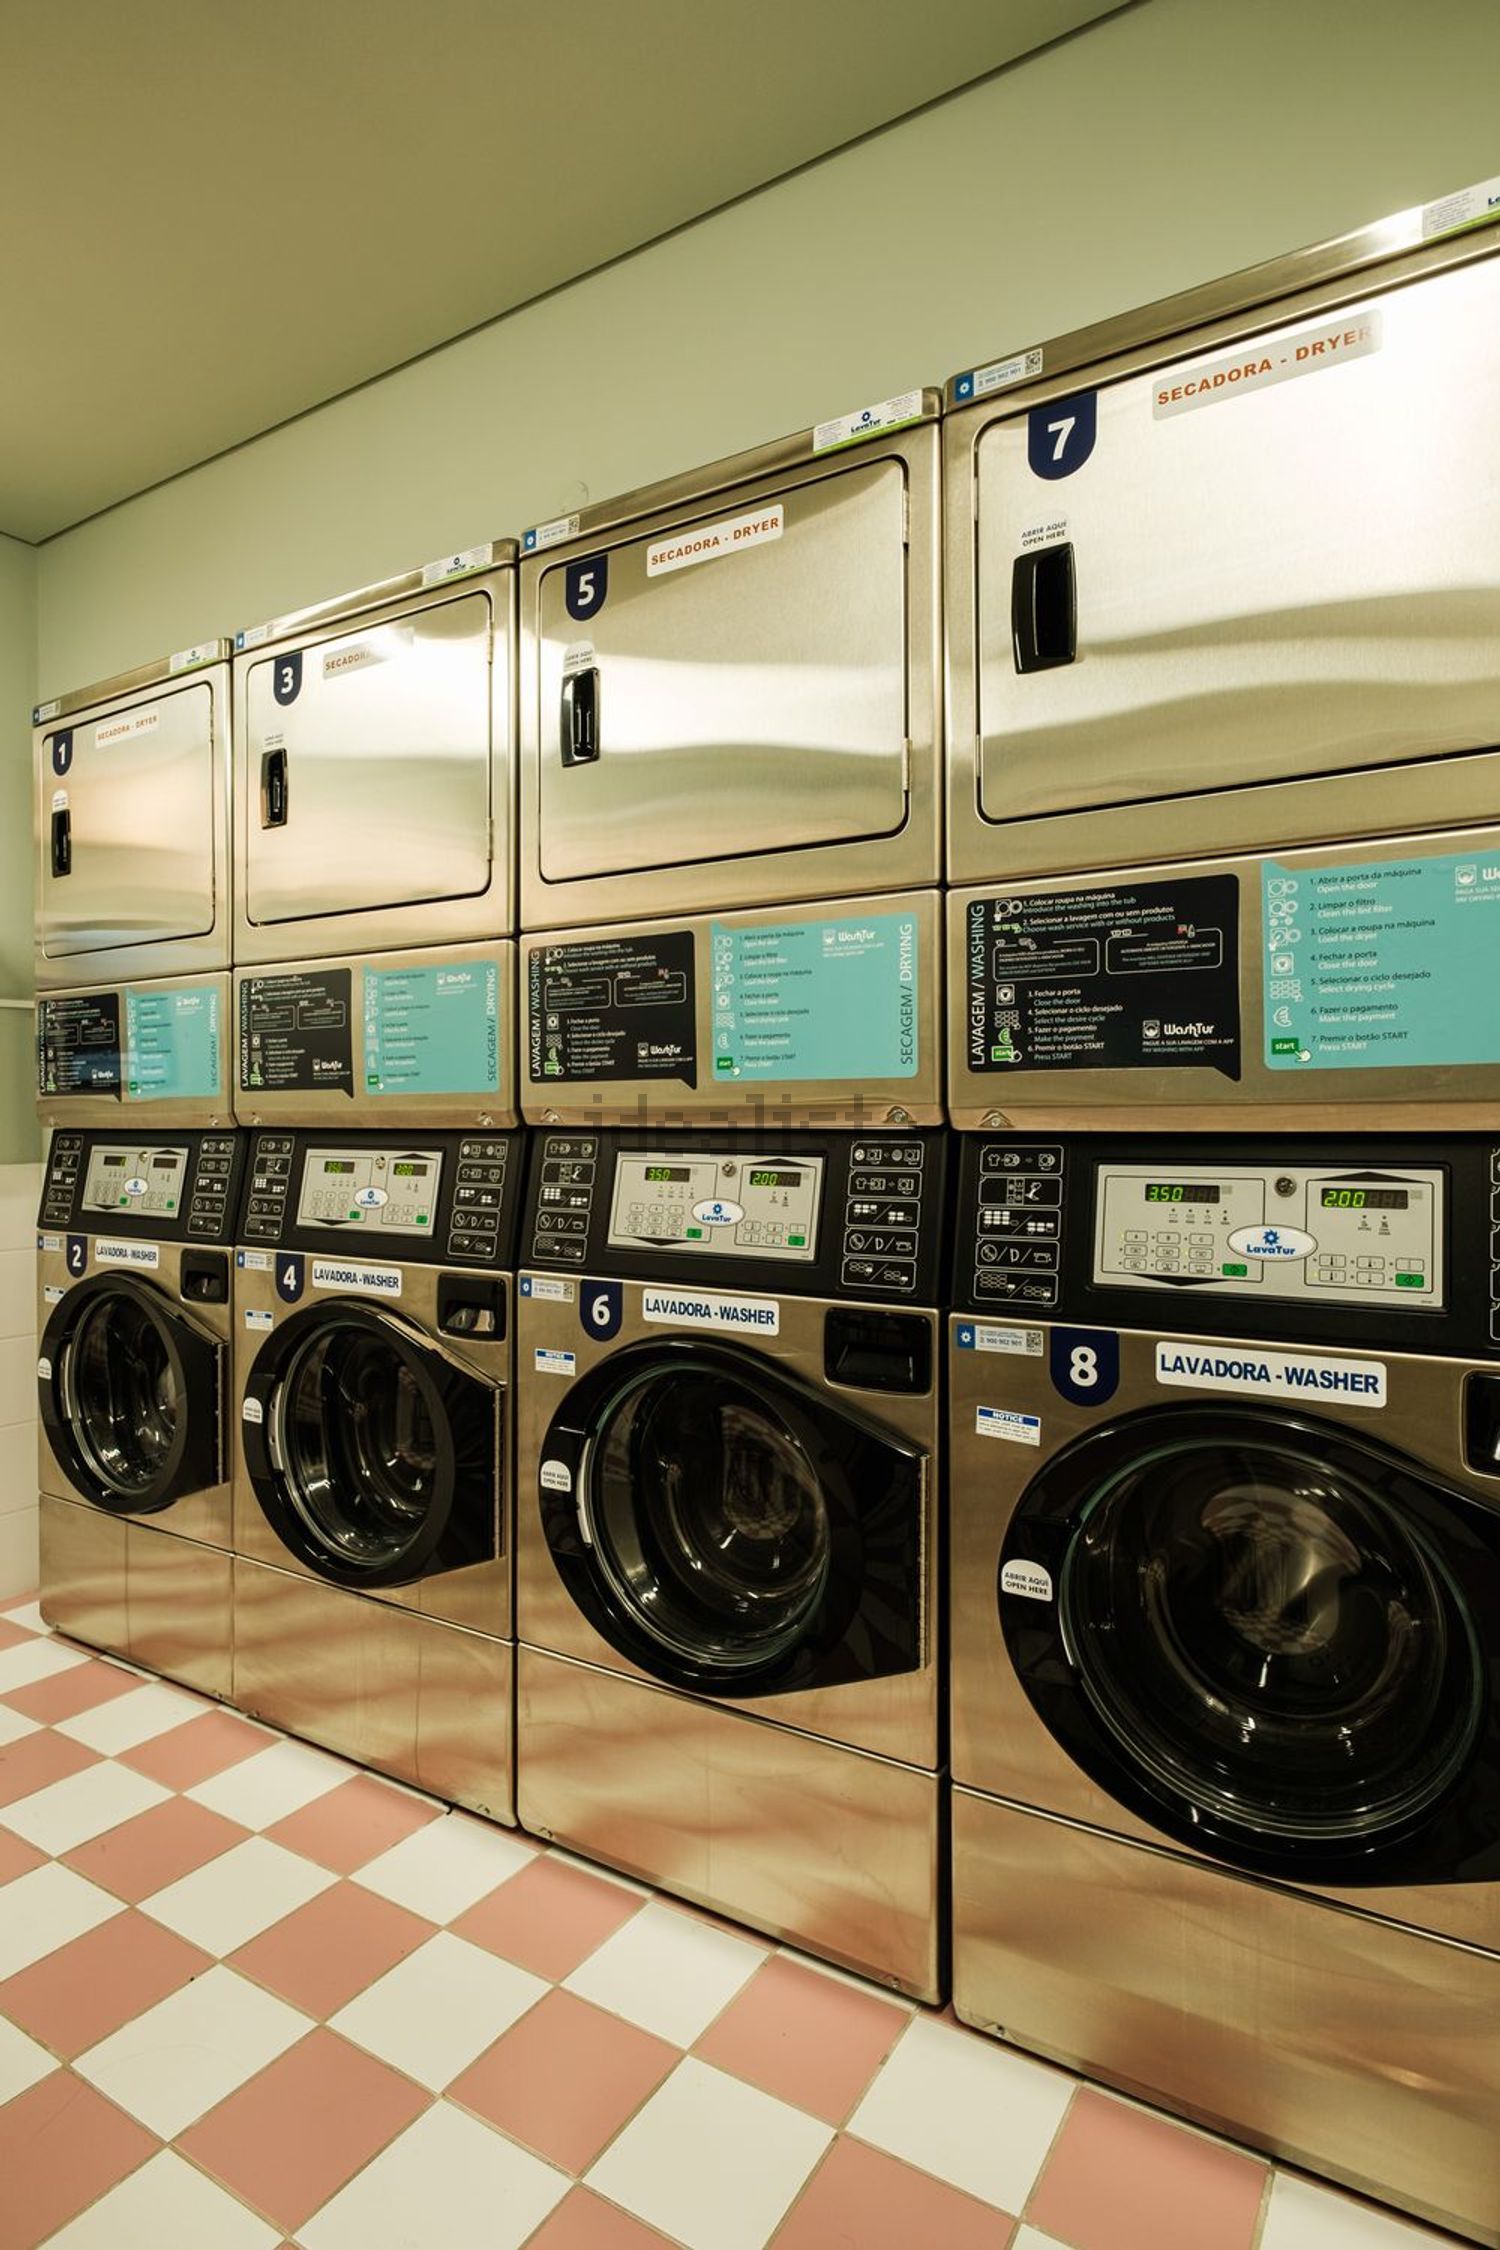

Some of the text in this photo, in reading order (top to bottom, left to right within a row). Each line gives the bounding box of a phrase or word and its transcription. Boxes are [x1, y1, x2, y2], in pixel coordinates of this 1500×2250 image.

[1158, 326, 1372, 405] SECADORA DRYER
[1047, 416, 1076, 461] 7
[1022, 527, 1043, 538] ABRIR
[651, 518, 779, 565] SECADORA DRYER
[1023, 537, 1043, 546] OPEN
[577, 572, 595, 606] 5
[281, 666, 294, 694] 3
[58, 743, 66, 765] 1
[1319, 875, 1338, 884] Abrir
[1347, 873, 1369, 882] porta
[1383, 868, 1421, 877] máquina
[1317, 885, 1340, 893] Open
[1029, 898, 1053, 906] Colocar
[1319, 901, 1347, 910] Limpar
[1356, 898, 1375, 906] filtro
[1030, 917, 1062, 925] Selecionar
[1142, 907, 1174, 916] produtos
[1319, 926, 1349, 935] Colocar
[1358, 924, 1382, 933] roupa
[1397, 919, 1435, 928] máquina
[838, 930, 875, 943] WashTur
[1319, 951, 1377, 961] Fechar porta
[971, 904, 986, 1065] WASHING LAVAGEM
[1320, 975, 1361, 985] Selecionar
[1392, 971, 1430, 981] desejado
[900, 923, 913, 1064] DRYING SECAGEM
[531, 951, 541, 1077] WASHING LAVAGEM
[1035, 1007, 1067, 1015] Selecionar
[1320, 1004, 1398, 1014] Fazer pagamento
[486, 968, 496, 1081] DRYING SECAGEM
[1059, 1025, 1097, 1033] pagamento
[1164, 1023, 1215, 1037] WashTur
[1320, 1034, 1348, 1042] Premir
[1356, 1033, 1380, 1041] botão
[1323, 1191, 1365, 1208] 2.00
[702, 1214, 732, 1223] LavaTur
[72, 1244, 82, 1267] 2
[1247, 1244, 1295, 1255] LavaTur
[283, 1265, 297, 1290] 4
[313, 1267, 399, 1289] LAVADORA WASHER
[592, 1294, 610, 1326] 6
[646, 1298, 775, 1325] LAVADORA WASHER
[1070, 1346, 1098, 1387] 8
[1161, 1354, 1379, 1394] LAVADORA WASHER
[992, 1411, 1024, 1424] NOTICE
